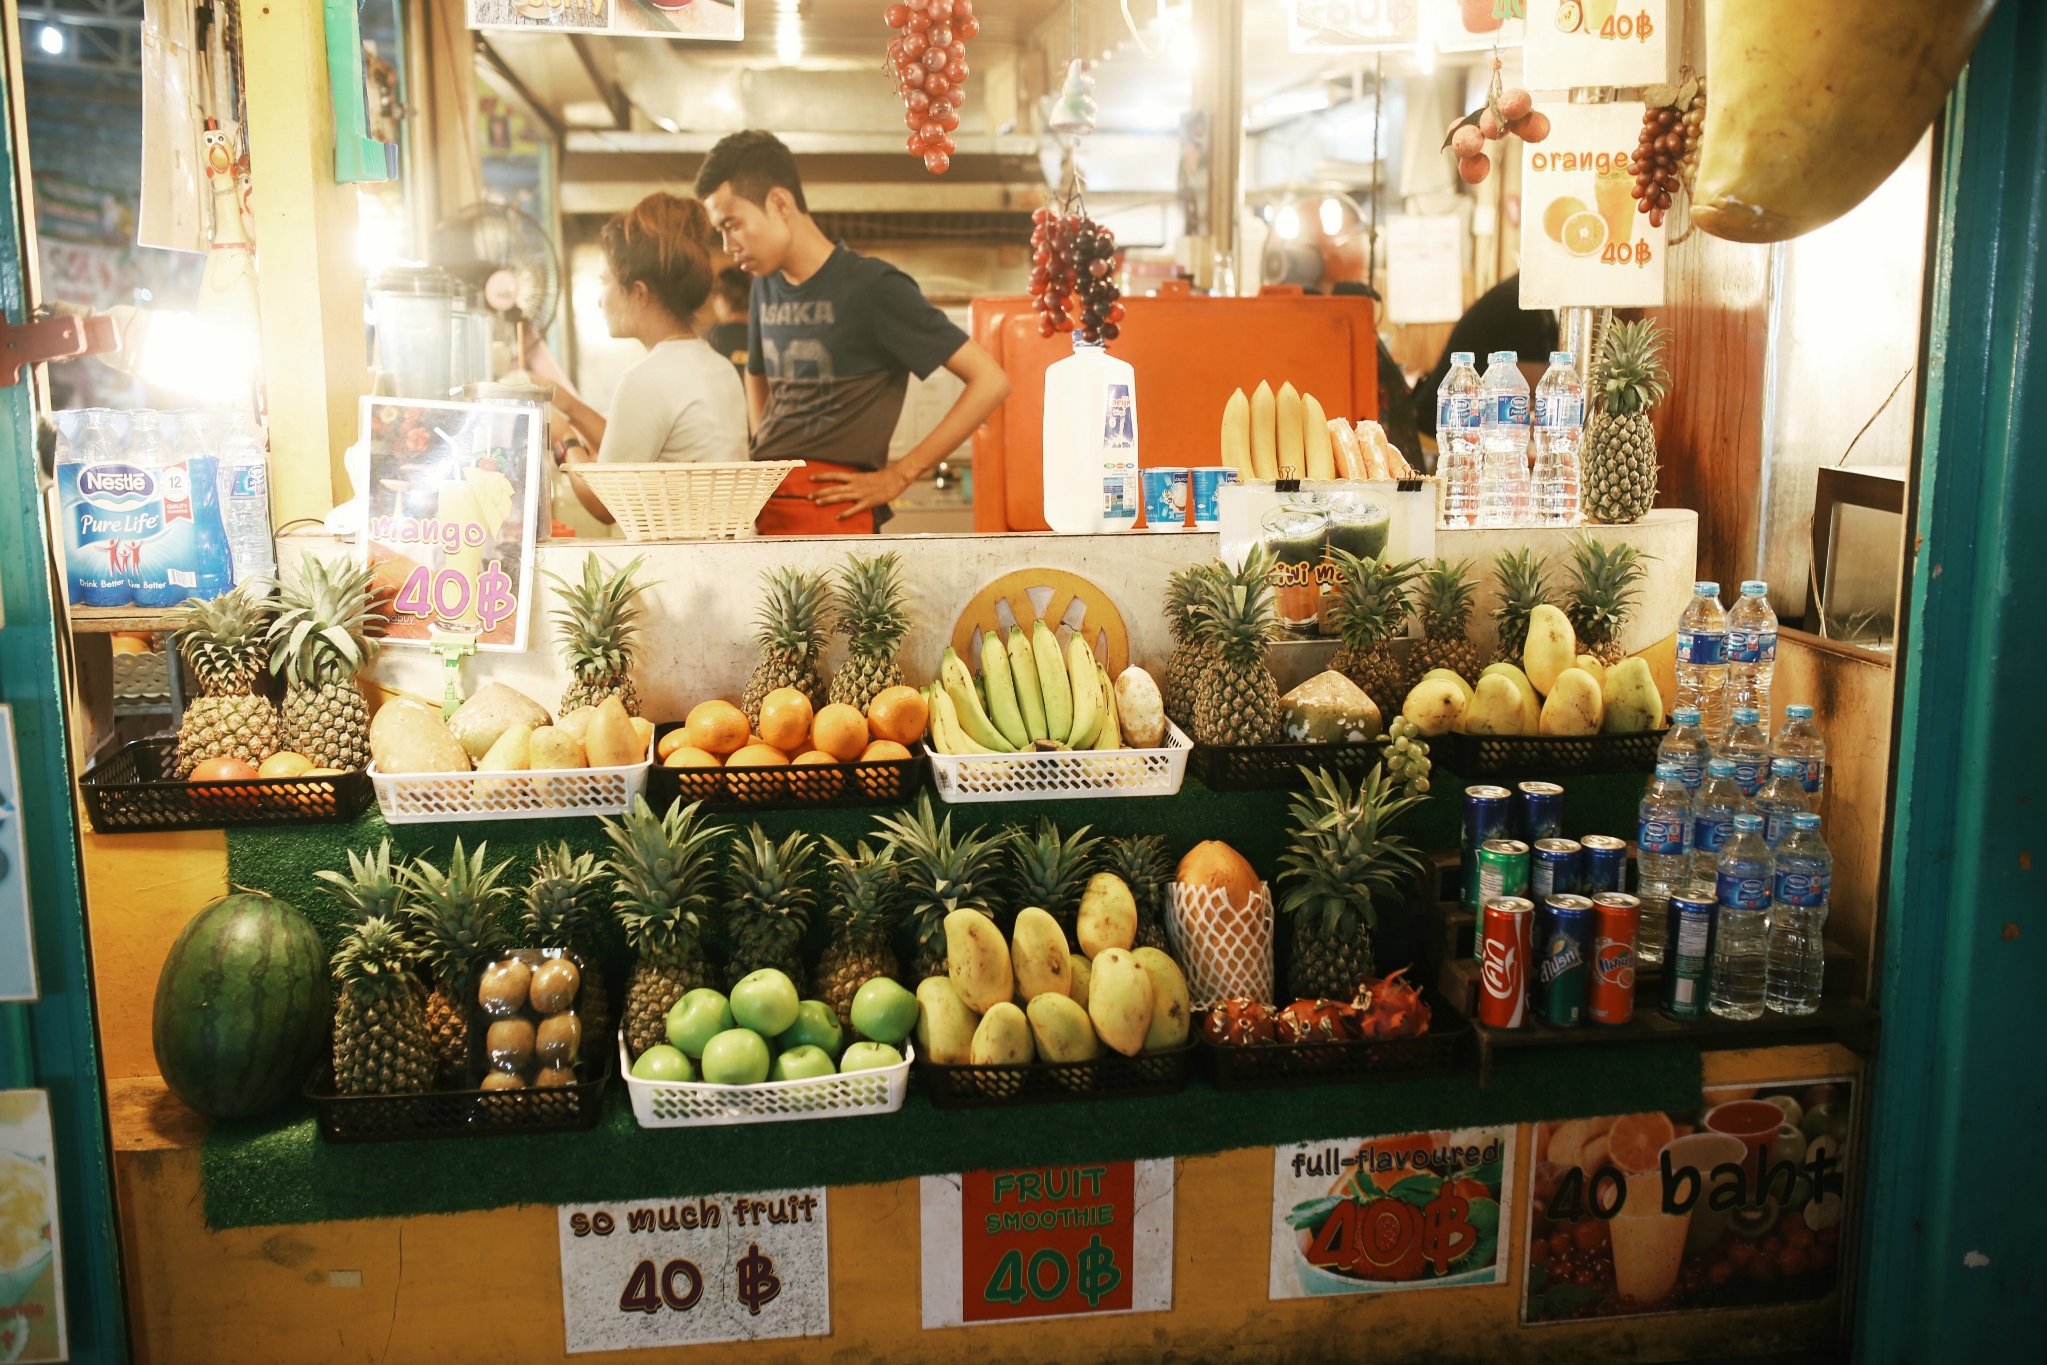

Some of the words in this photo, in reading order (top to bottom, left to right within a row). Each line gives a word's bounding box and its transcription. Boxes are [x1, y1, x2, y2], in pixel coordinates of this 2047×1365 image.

[1600, 9, 1654, 42] 40฿
[1531, 151, 1630, 177] orange
[1600, 237, 1653, 268] 40฿
[168, 475, 182, 488] 12
[81, 514, 122, 534] Pure
[372, 515, 486, 554] mango
[79, 578, 98, 588] Drink
[101, 578, 126, 588] Better
[143, 580, 168, 590] Better
[393, 560, 518, 632] 40฿
[1291, 1138, 1501, 1178] full-flavoured
[993, 1167, 1107, 1204] FRUIT
[1546, 1165, 1628, 1223] 40
[1660, 1143, 1838, 1216] baht
[570, 1211, 615, 1237] so
[627, 1196, 722, 1234] much
[732, 1194, 818, 1227] fruit
[985, 1204, 1115, 1234] SMOOTHIE
[1307, 1180, 1478, 1278] 40฿
[619, 1257, 704, 1314] 40
[984, 1235, 1122, 1307] 40฿
